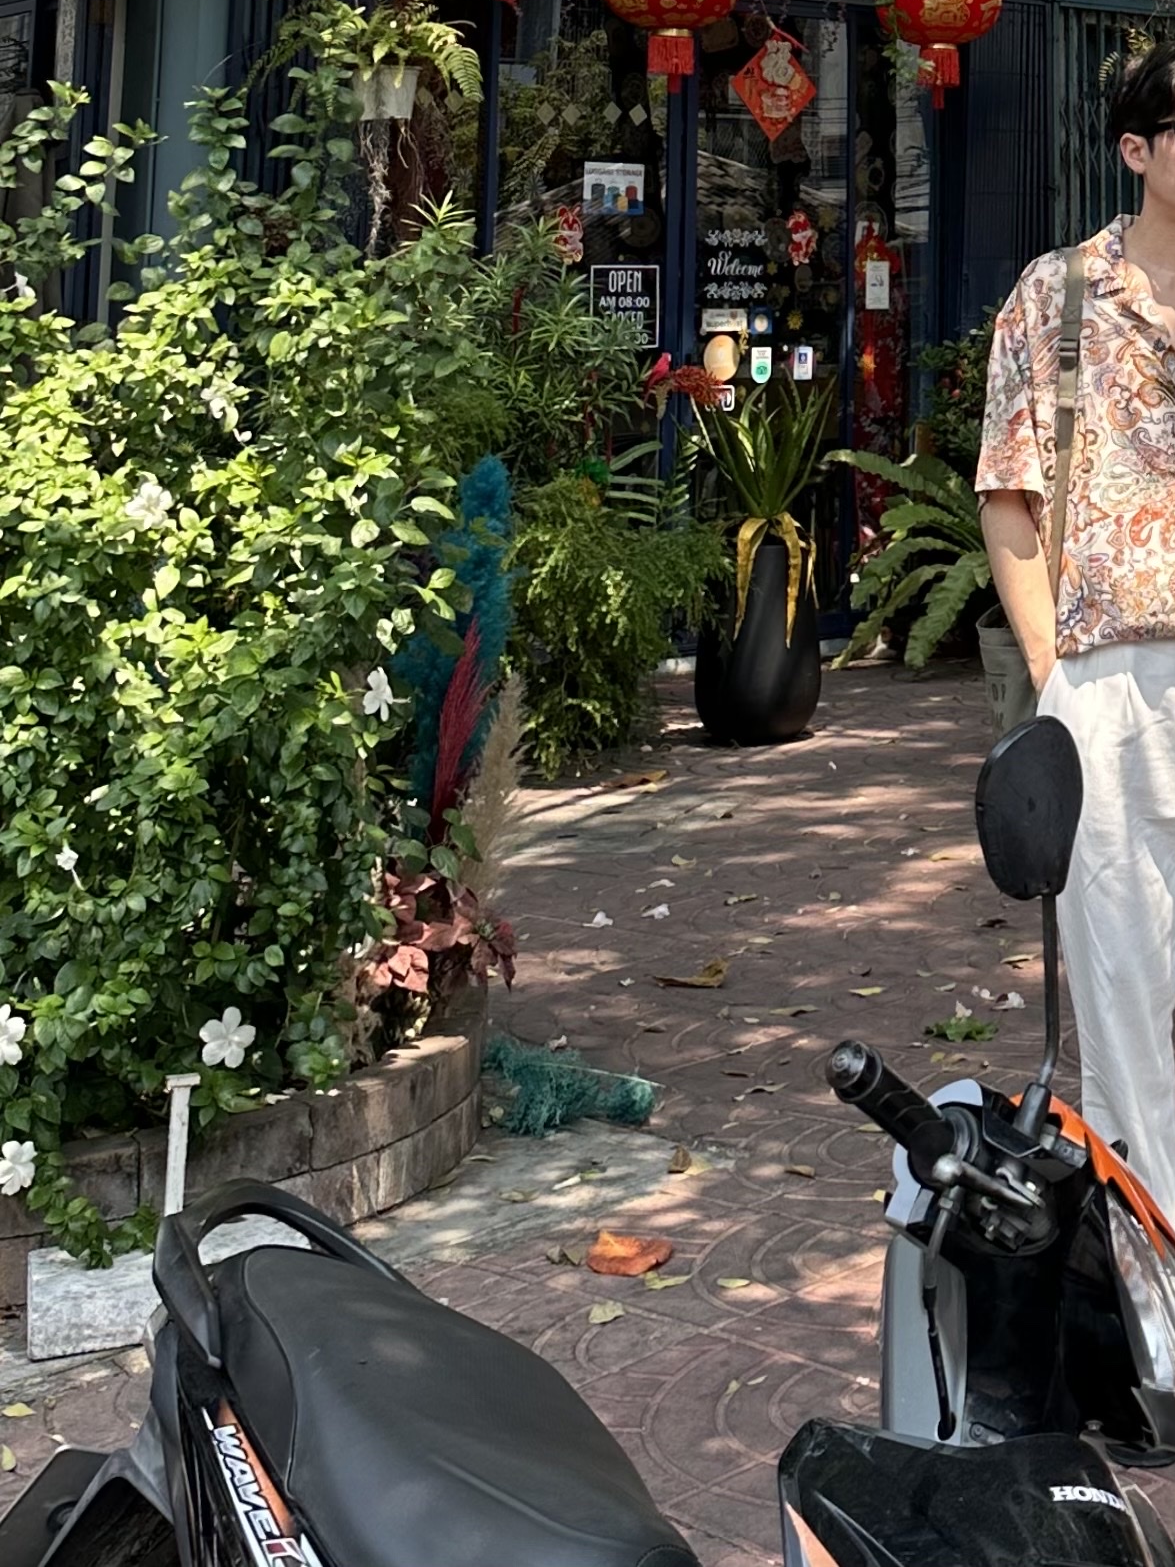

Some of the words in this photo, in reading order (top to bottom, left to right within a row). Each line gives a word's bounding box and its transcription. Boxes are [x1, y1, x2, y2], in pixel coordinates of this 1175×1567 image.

[707, 250, 764, 278] Welcome
[608, 270, 642, 293] OPEN
[599, 296, 616, 308] AM
[618, 296, 650, 308] 08:00
[213, 1423, 281, 1540] WAVE
